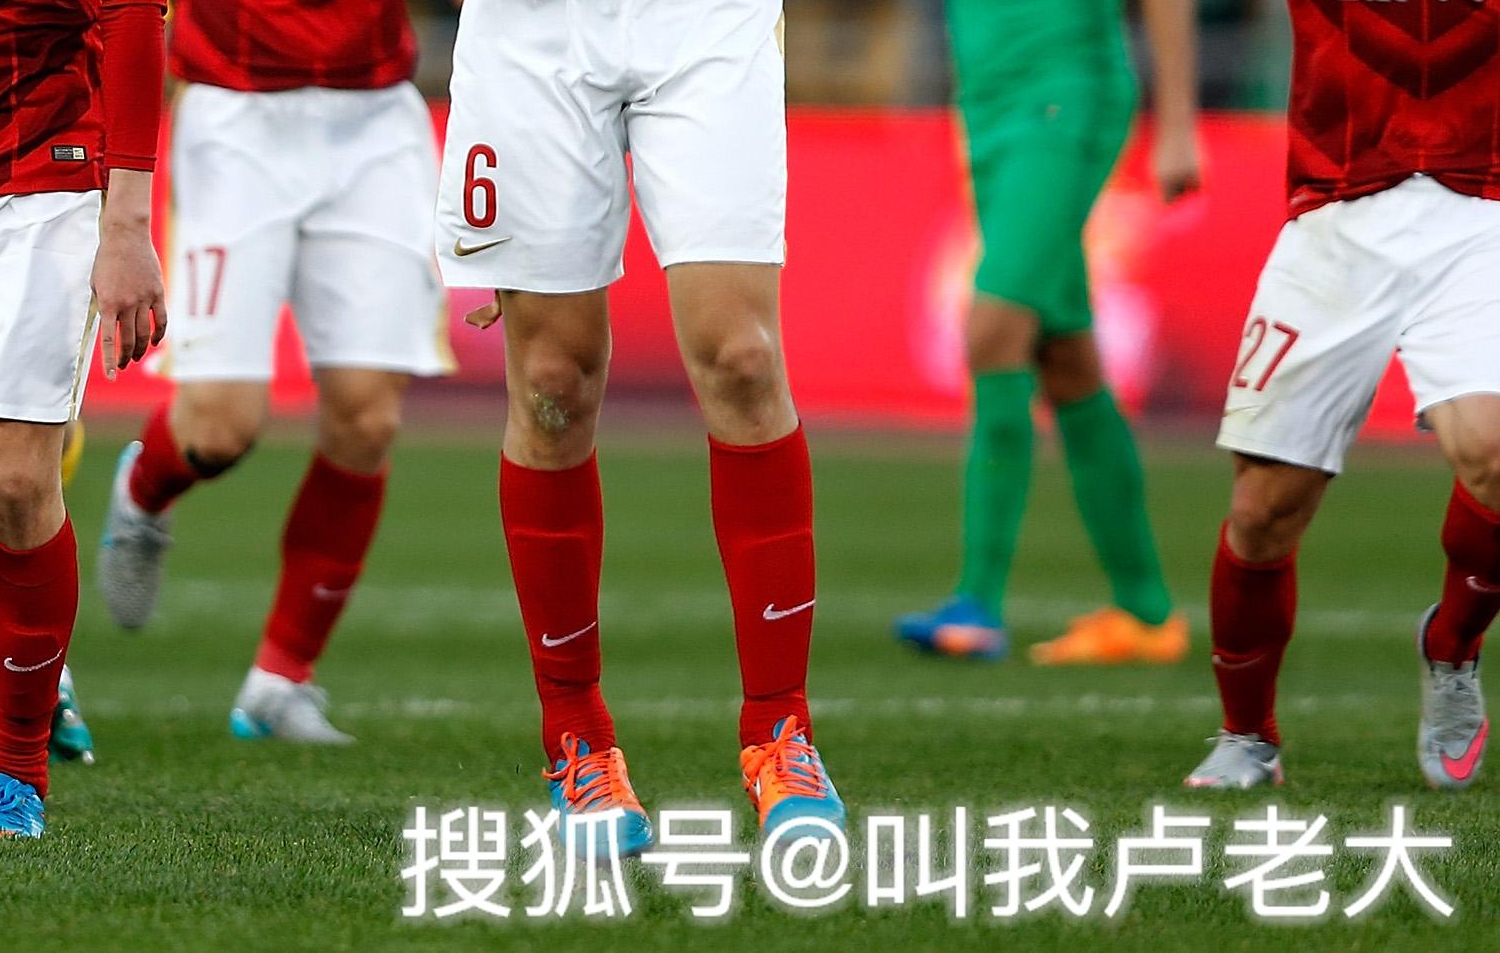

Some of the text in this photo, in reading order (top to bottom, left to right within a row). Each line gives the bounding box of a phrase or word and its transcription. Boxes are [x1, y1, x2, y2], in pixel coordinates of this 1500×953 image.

[463, 143, 497, 229] 6
[186, 245, 228, 318] 17
[1233, 314, 1300, 392] 27
